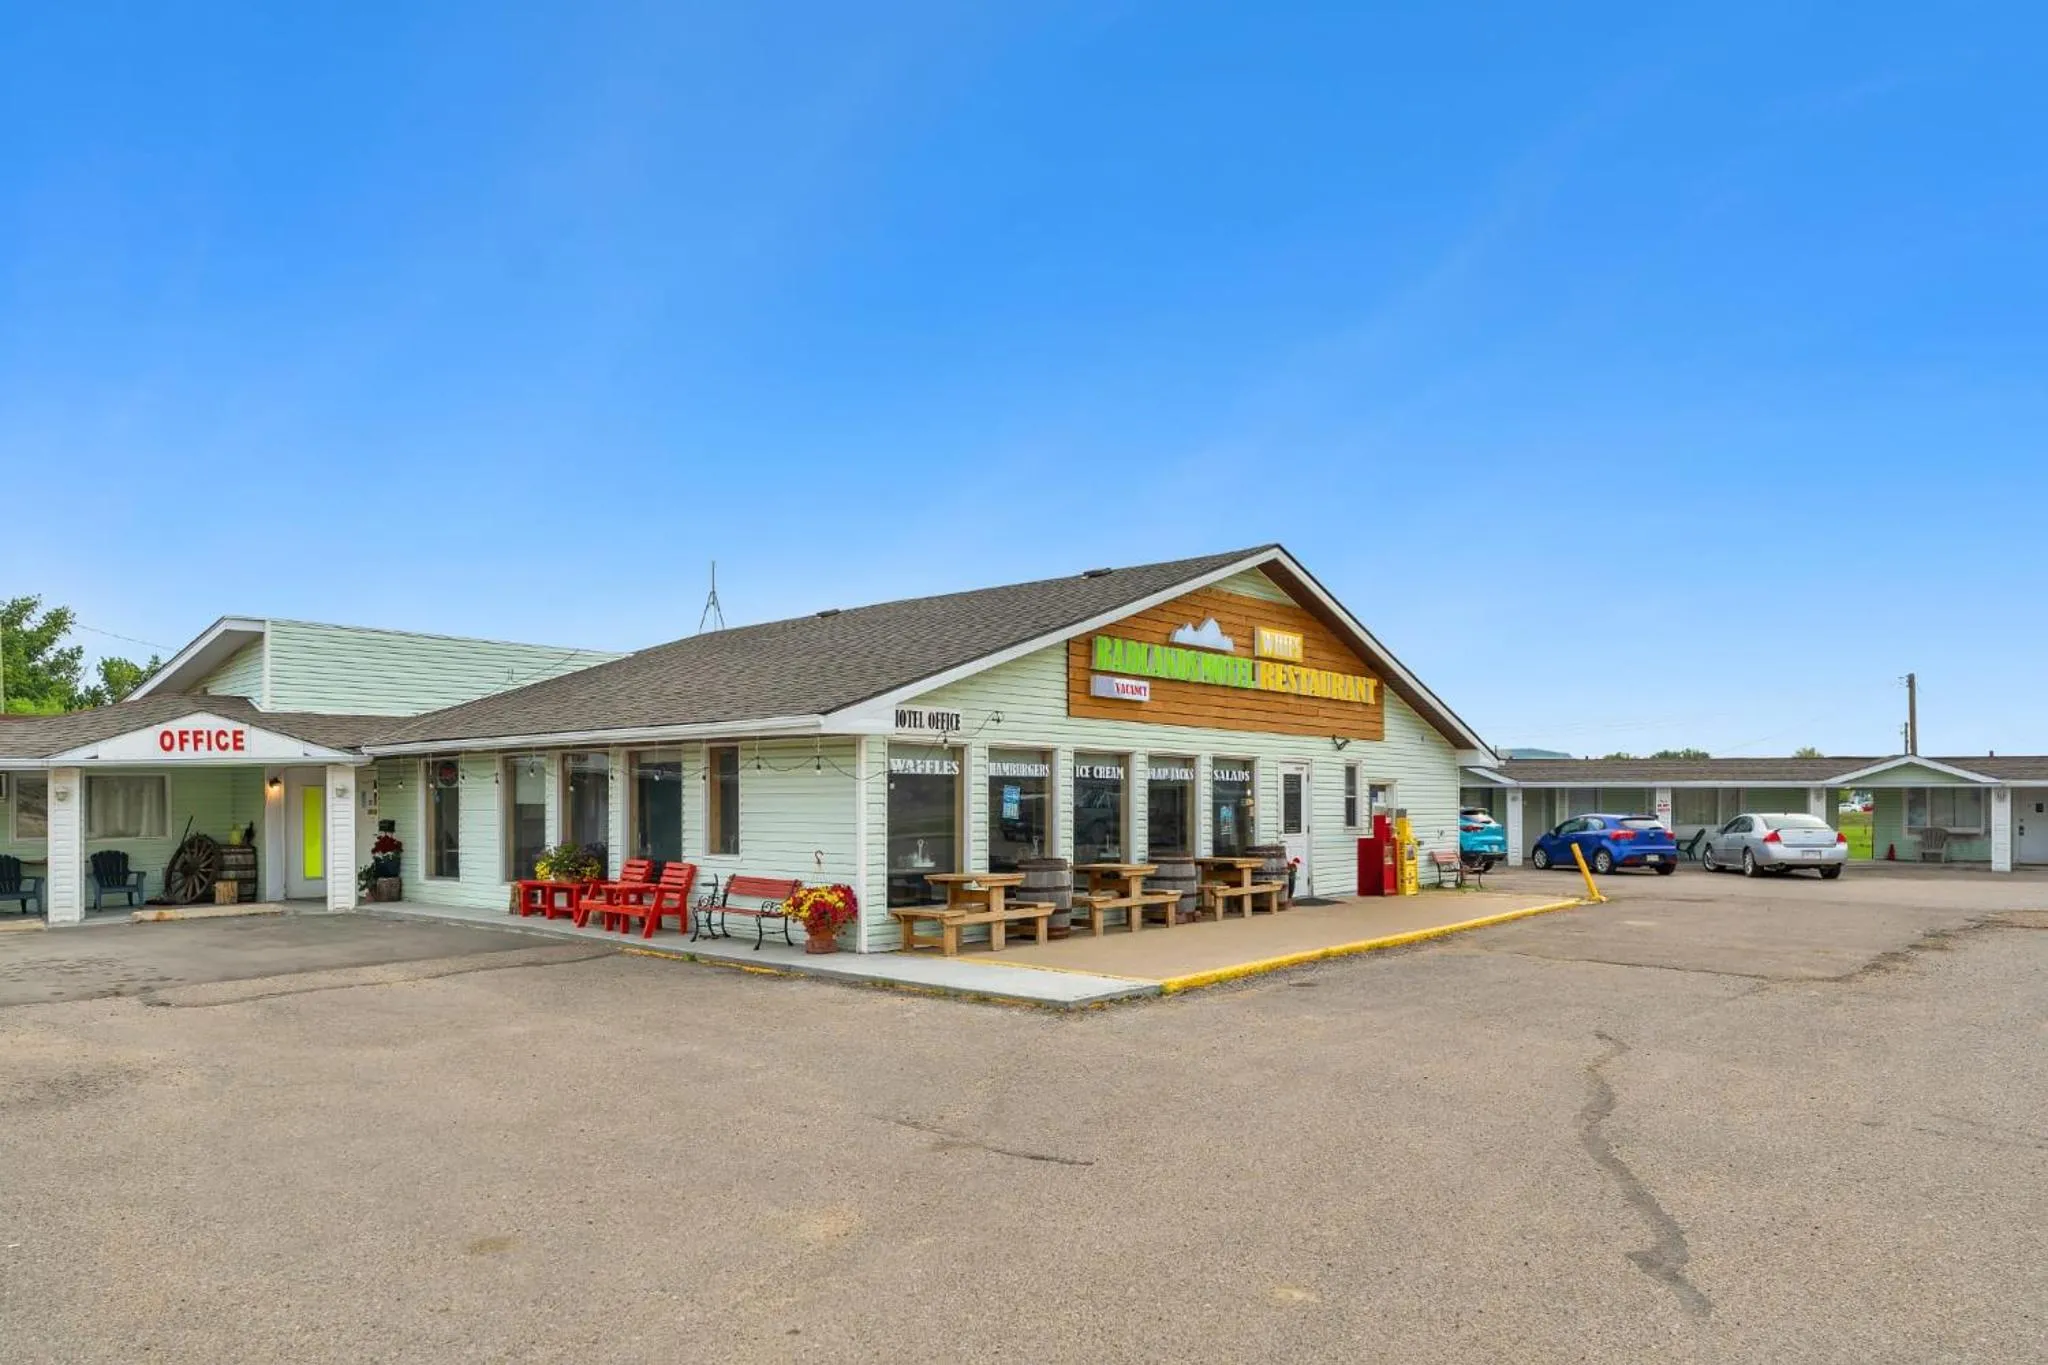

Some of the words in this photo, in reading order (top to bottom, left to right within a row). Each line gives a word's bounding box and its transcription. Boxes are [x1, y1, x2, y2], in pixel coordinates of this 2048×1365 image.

[1115, 682, 1148, 697] VACANCY
[1259, 661, 1378, 704] RESTAURANT
[928, 711, 960, 731] OFFICE
[159, 729, 245, 752] OFFICE
[889, 758, 960, 775] WAFFLES
[988, 762, 1050, 777] HAMBURGERS
[1075, 764, 1091, 778] ICE
[1093, 765, 1124, 780] CREAM
[1213, 768, 1250, 782] SALADS
